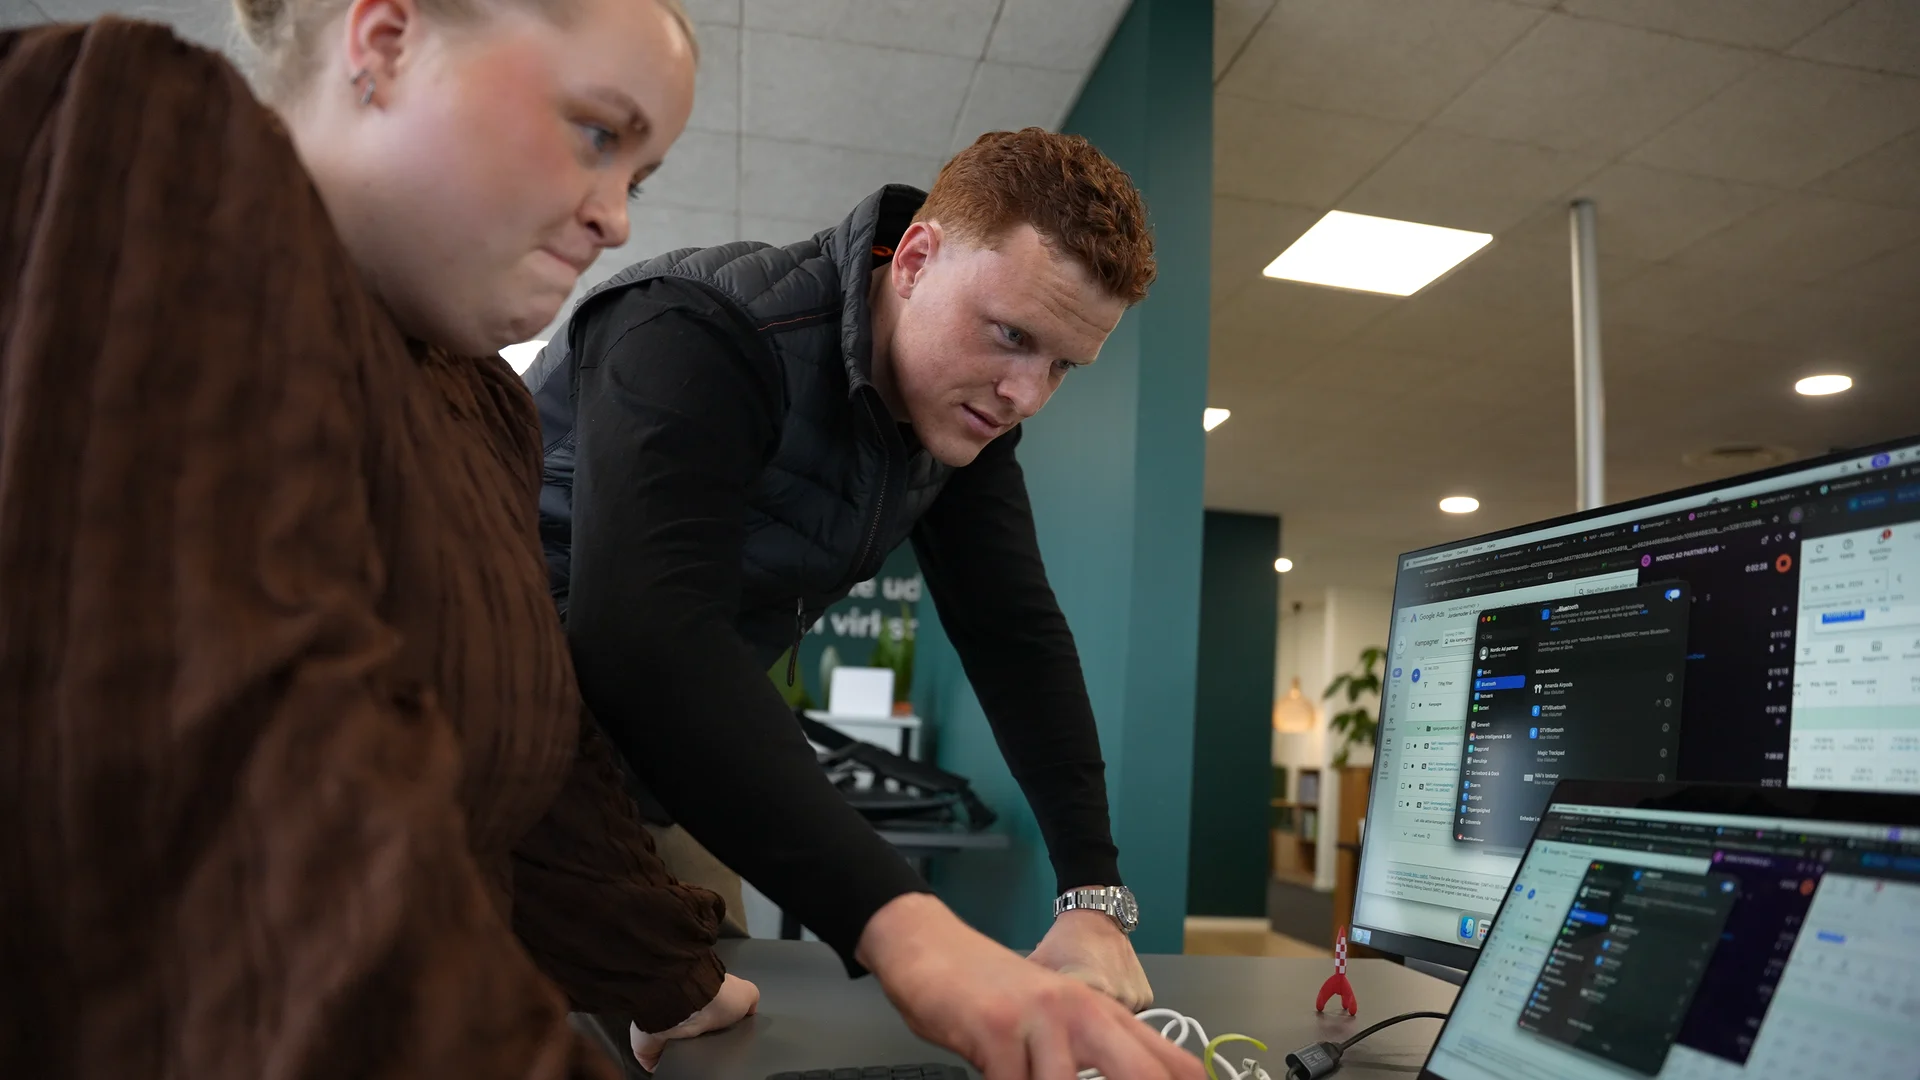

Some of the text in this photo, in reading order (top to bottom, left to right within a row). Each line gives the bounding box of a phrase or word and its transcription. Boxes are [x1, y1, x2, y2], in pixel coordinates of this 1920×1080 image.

[1656, 553, 1675, 562] NORDIC
[1683, 547, 1708, 557] PARTNER
[882, 573, 923, 602] ud
[1557, 603, 1579, 612] Bluetooth
[1419, 613, 1435, 621] Google
[1414, 638, 1440, 647] Kampagner
